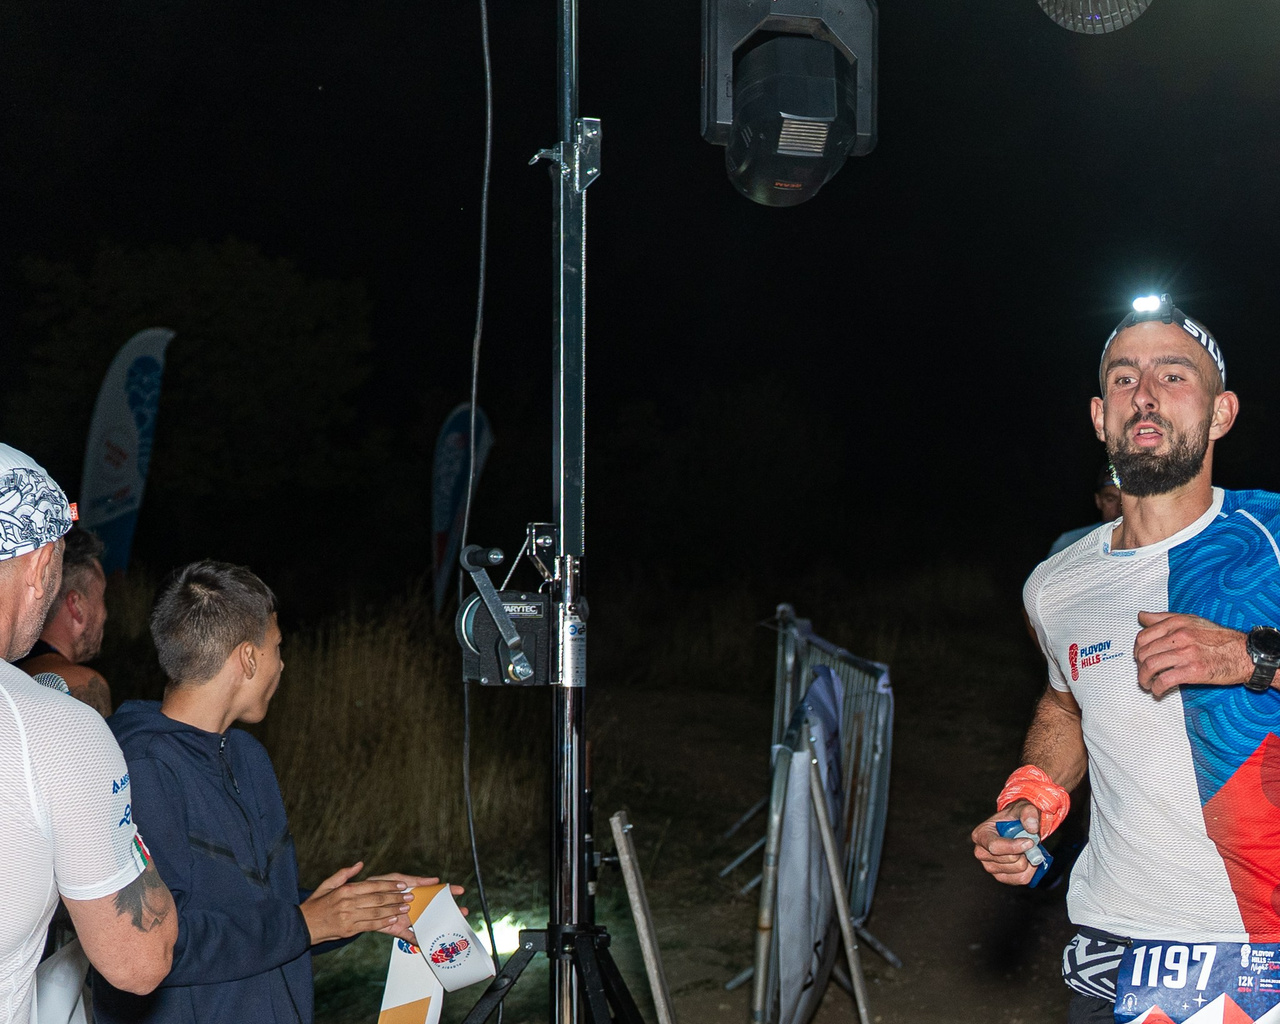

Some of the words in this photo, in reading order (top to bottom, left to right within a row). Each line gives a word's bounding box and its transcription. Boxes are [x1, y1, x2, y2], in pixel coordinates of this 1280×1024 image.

[1080, 640, 1111, 657] PLOVDIV
[1081, 654, 1101, 669] HILLS
[1131, 945, 1217, 991] 1197
[1238, 976, 1254, 987] 12K
